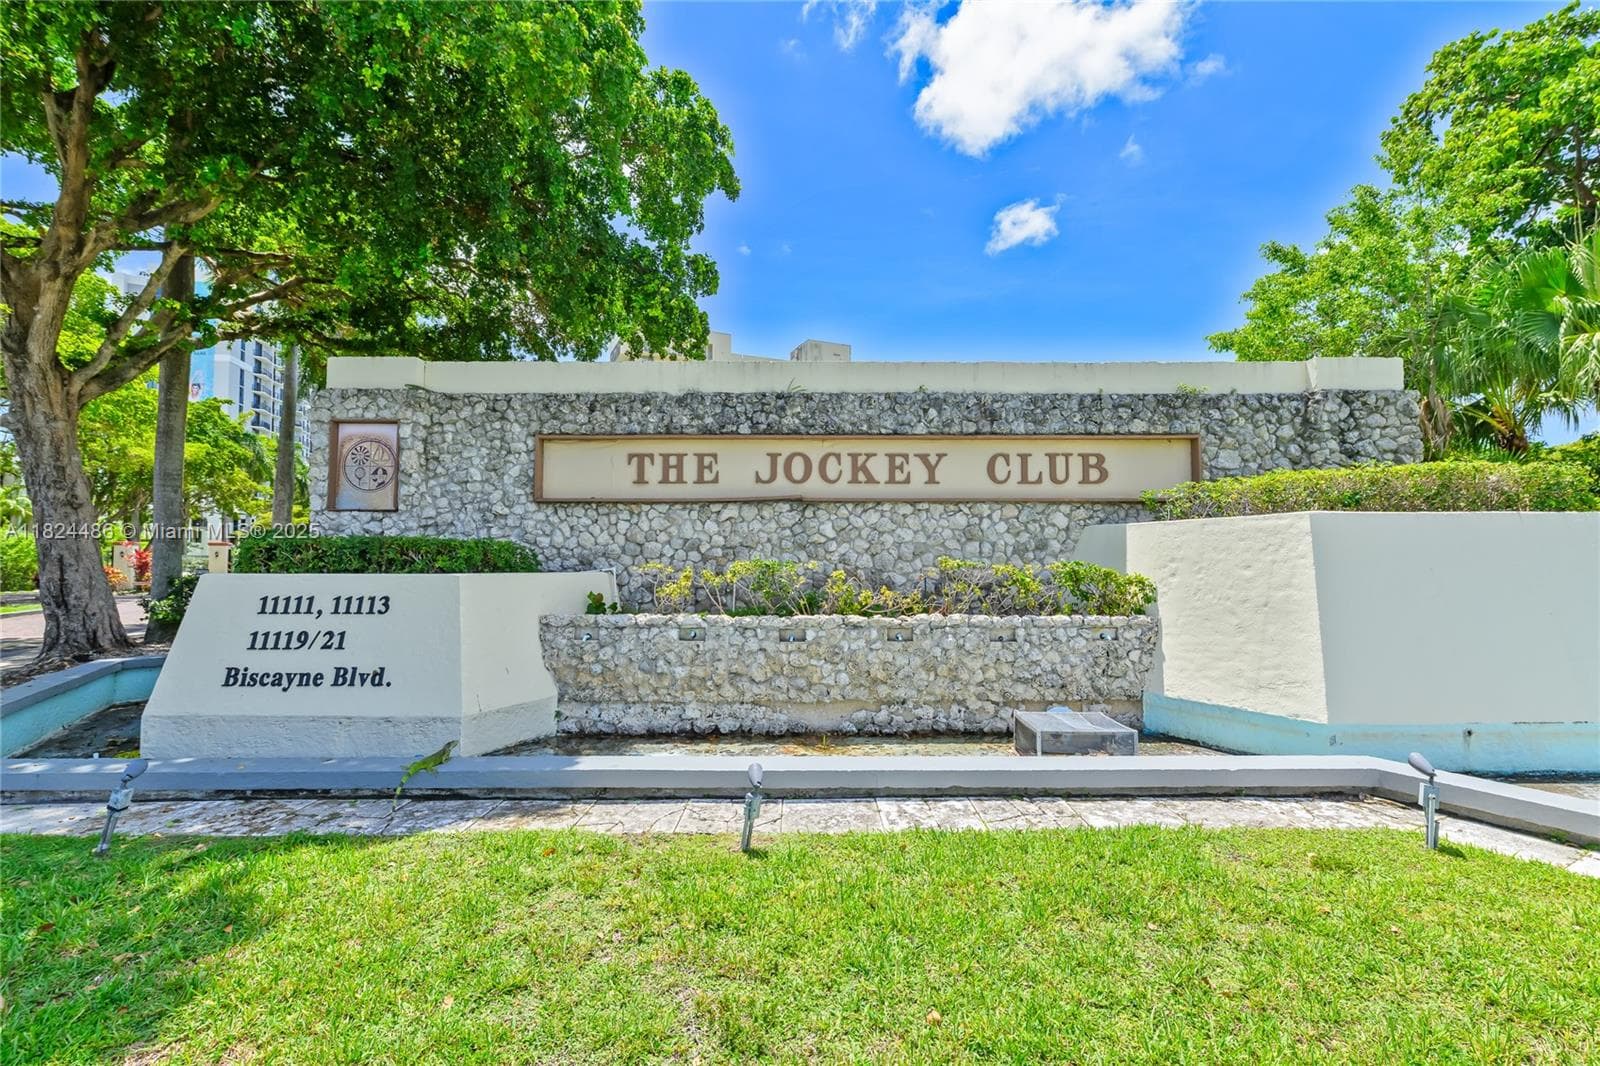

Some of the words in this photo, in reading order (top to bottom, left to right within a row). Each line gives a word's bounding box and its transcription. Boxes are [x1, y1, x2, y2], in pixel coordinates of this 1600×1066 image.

[627, 452, 720, 484] THE
[755, 452, 948, 485] JOCKEY
[986, 452, 1109, 485] CLUB
[257, 595, 323, 619] 11111,
[330, 595, 391, 615] 11113
[246, 630, 347, 651] 11119/21
[221, 666, 325, 692] Biscayne
[330, 666, 392, 687] Blvd.
